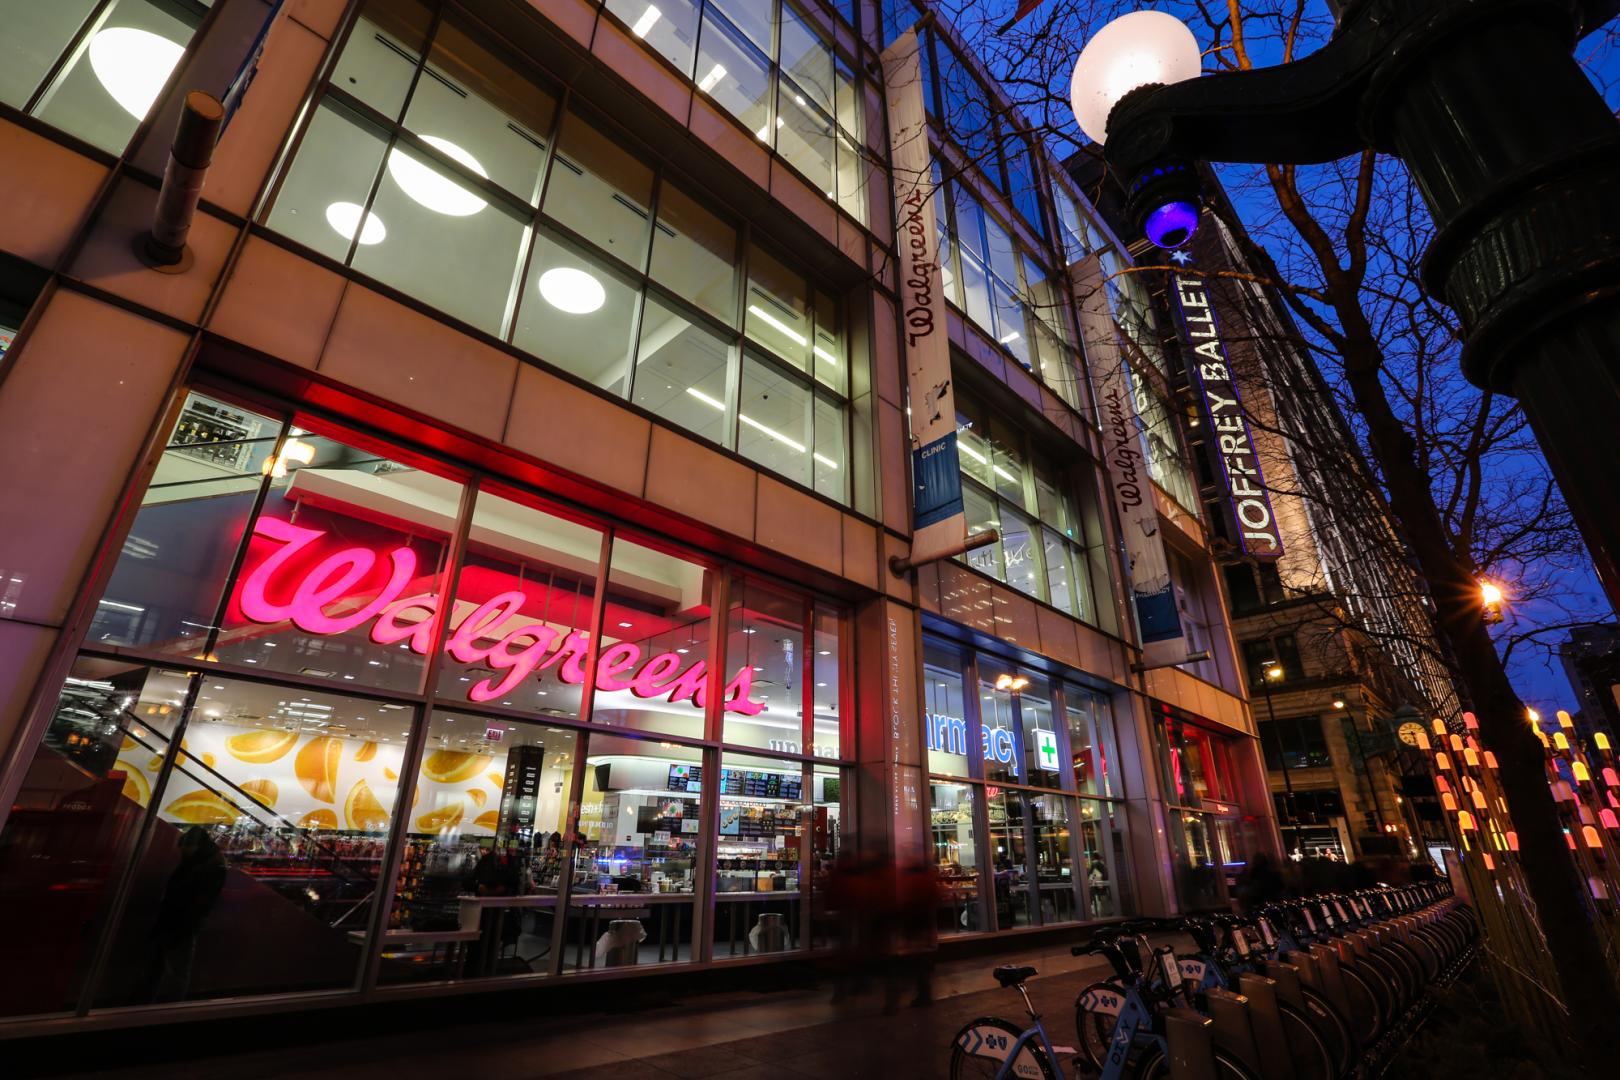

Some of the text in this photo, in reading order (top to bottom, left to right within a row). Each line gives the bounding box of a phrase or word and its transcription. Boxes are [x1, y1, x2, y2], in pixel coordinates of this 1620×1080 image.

[905, 188, 937, 348] Walgreens
[921, 441, 947, 459] CLINIC
[1104, 388, 1143, 513] Walgreens
[1176, 277, 1277, 551] JOFFREY BALLET
[239, 516, 765, 715] Walgreens
